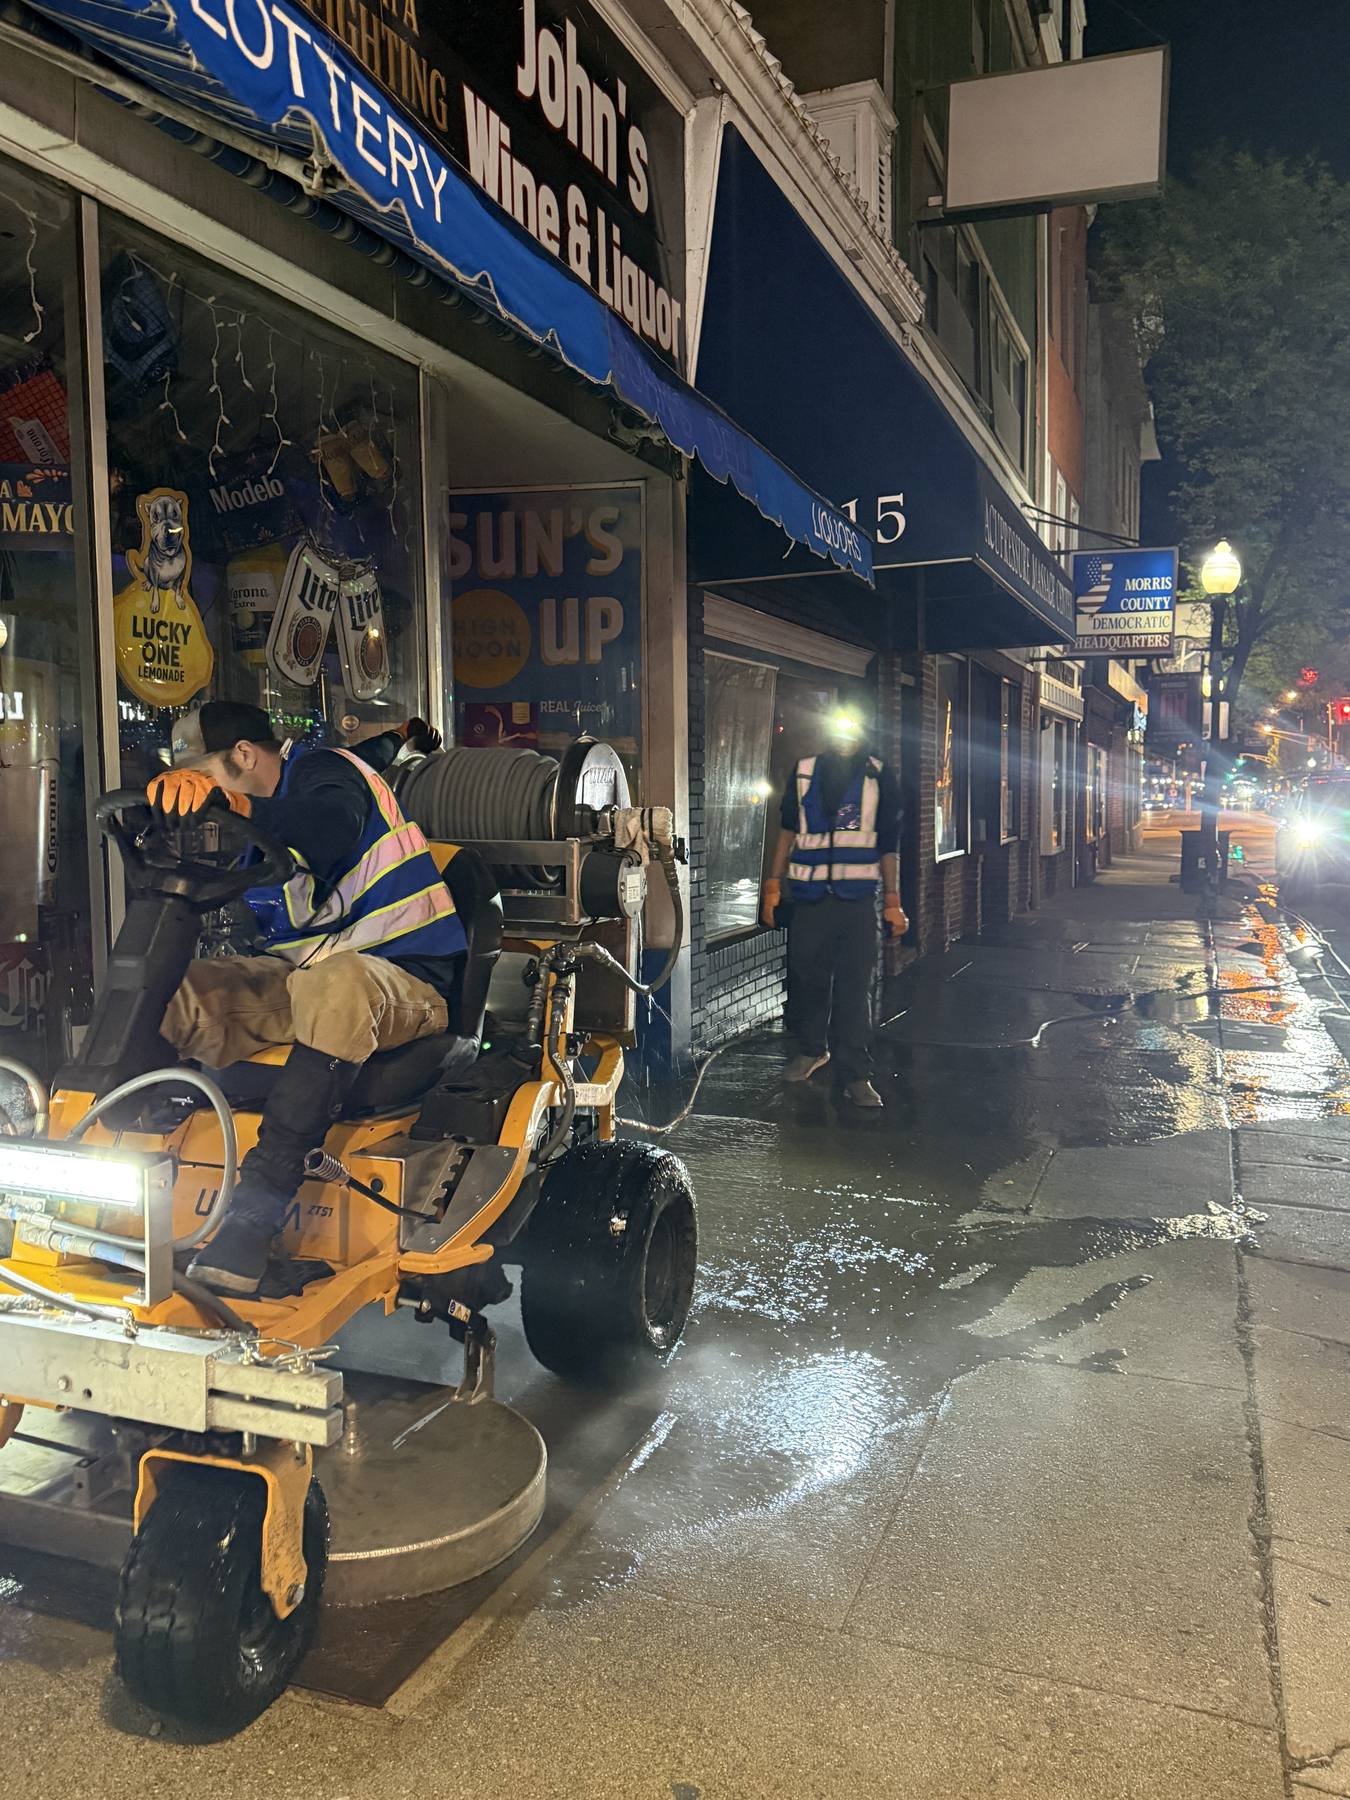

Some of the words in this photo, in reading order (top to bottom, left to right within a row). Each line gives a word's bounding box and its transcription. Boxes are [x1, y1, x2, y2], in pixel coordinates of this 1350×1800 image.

[309, 0, 448, 132] IGHTING
[516, 0, 649, 214] John's
[462, 82, 560, 259] Wine
[566, 184, 591, 286] &
[597, 206, 681, 358] Liquor
[208, 475, 285, 514] Modelo
[449, 505, 625, 580] SUN'S
[811, 502, 862, 562] LIQUORS
[298, 565, 338, 612] Lite
[1124, 576, 1173, 592] MORRIS
[346, 583, 380, 632] Lite
[1092, 615, 1171, 631] DEMOCRATIC
[1120, 596, 1172, 612] COUNTY
[132, 615, 192, 646] LUCKY
[453, 618, 515, 637] HIGH
[540, 596, 625, 666] UP
[1075, 633, 1170, 652] HEADQUARTERS
[452, 639, 522, 659] NOON
[138, 665, 185, 683] LEMONADE
[540, 700, 570, 714] REAL
[46, 778, 59, 874] Corona
